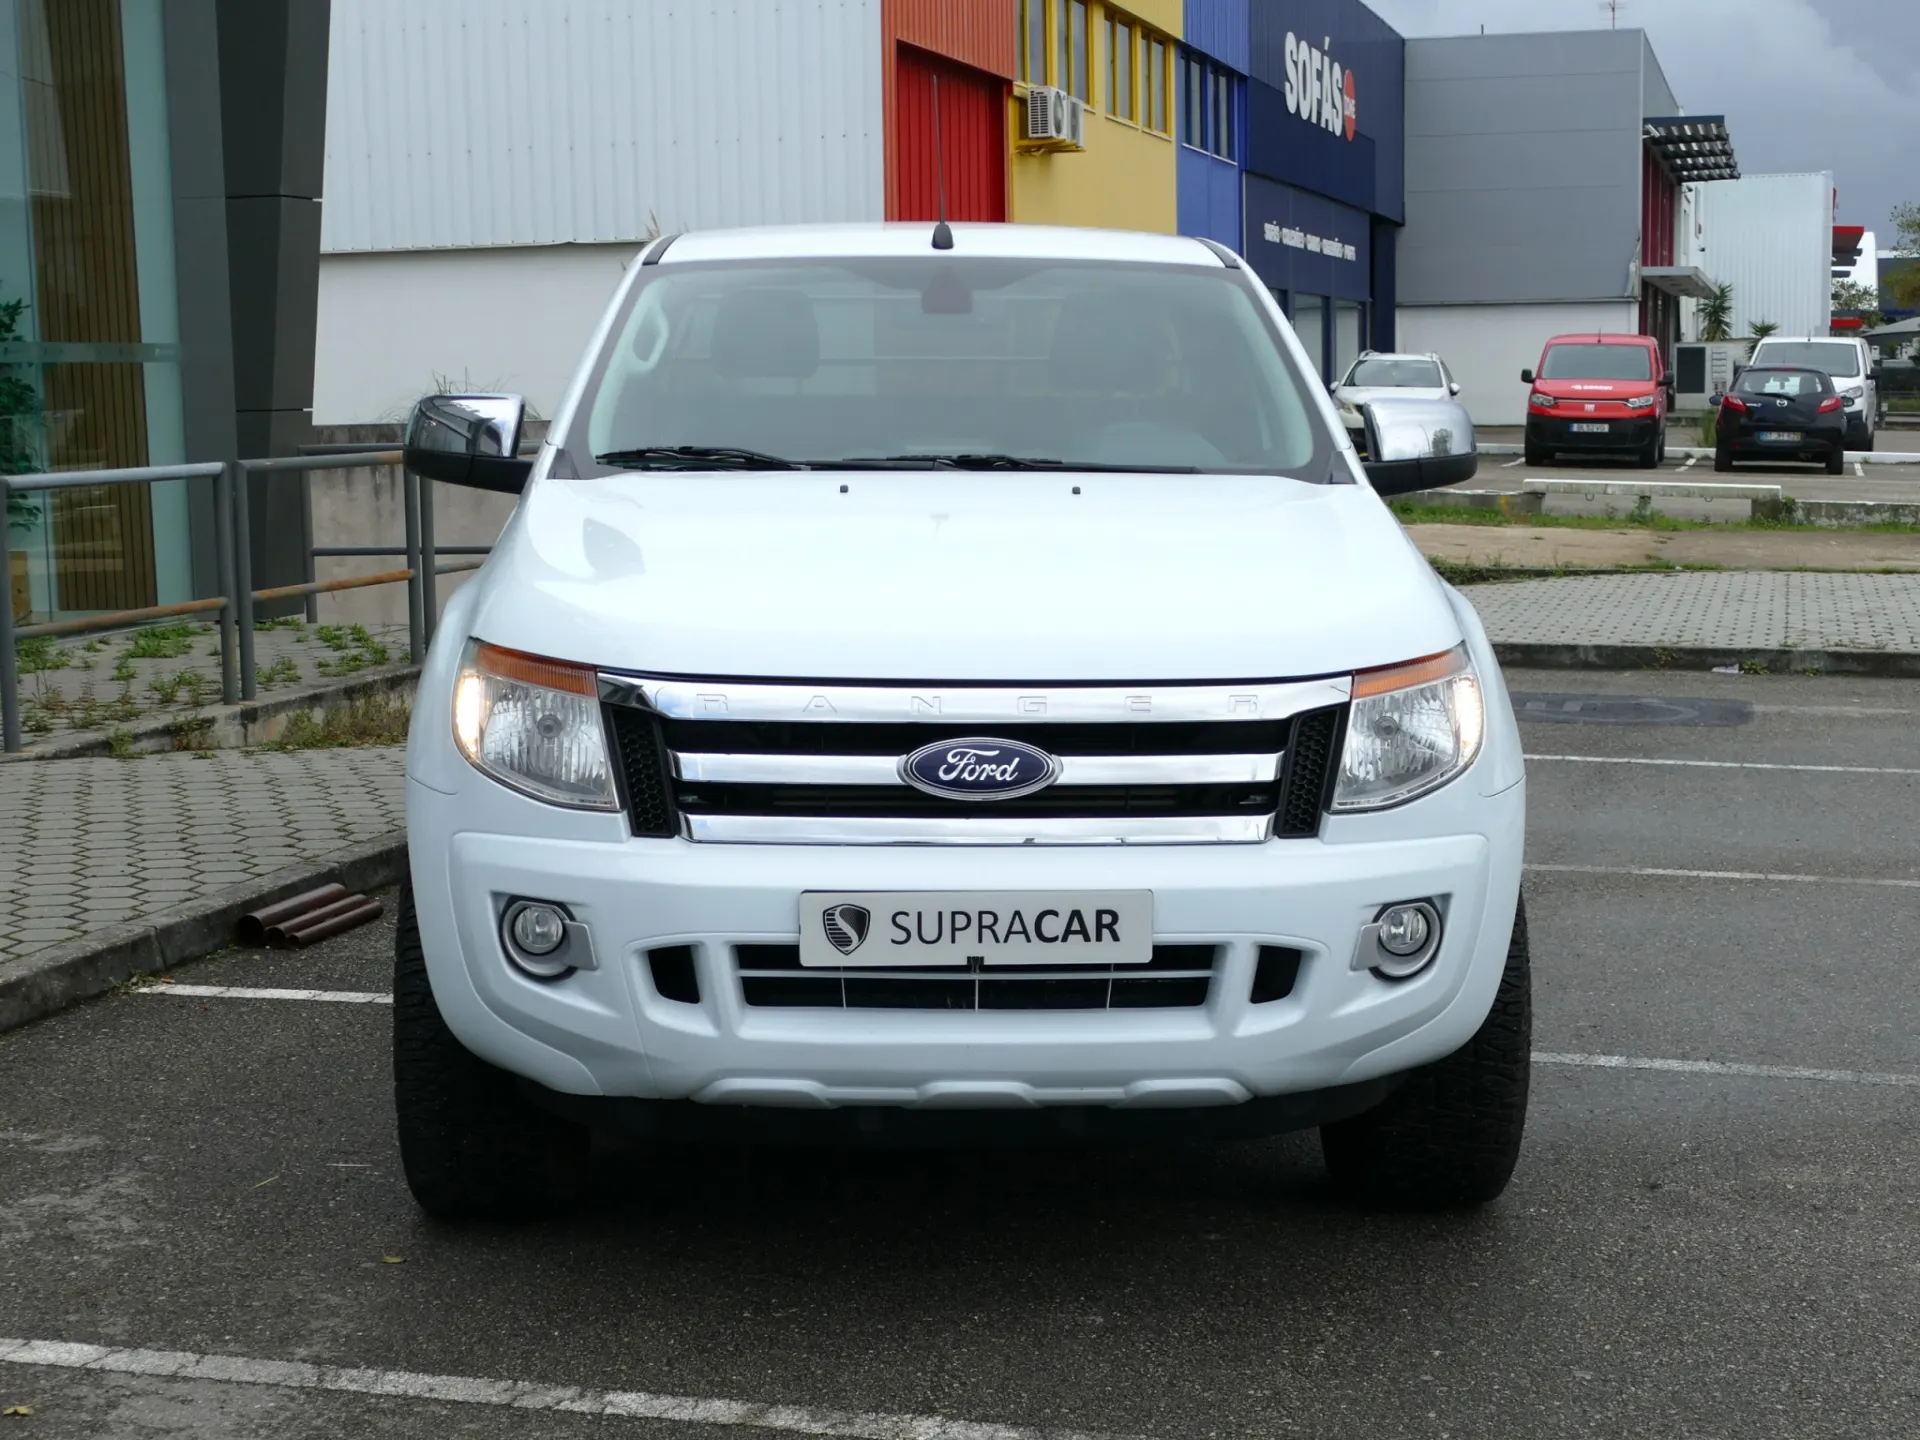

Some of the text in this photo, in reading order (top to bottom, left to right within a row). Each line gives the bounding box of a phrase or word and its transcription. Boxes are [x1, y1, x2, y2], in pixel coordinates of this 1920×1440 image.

[1284, 31, 1342, 137] SOFÁS
[695, 693, 1260, 714] RANGER
[938, 748, 1020, 781] Ford
[890, 909, 1121, 945] SUPRACAR
